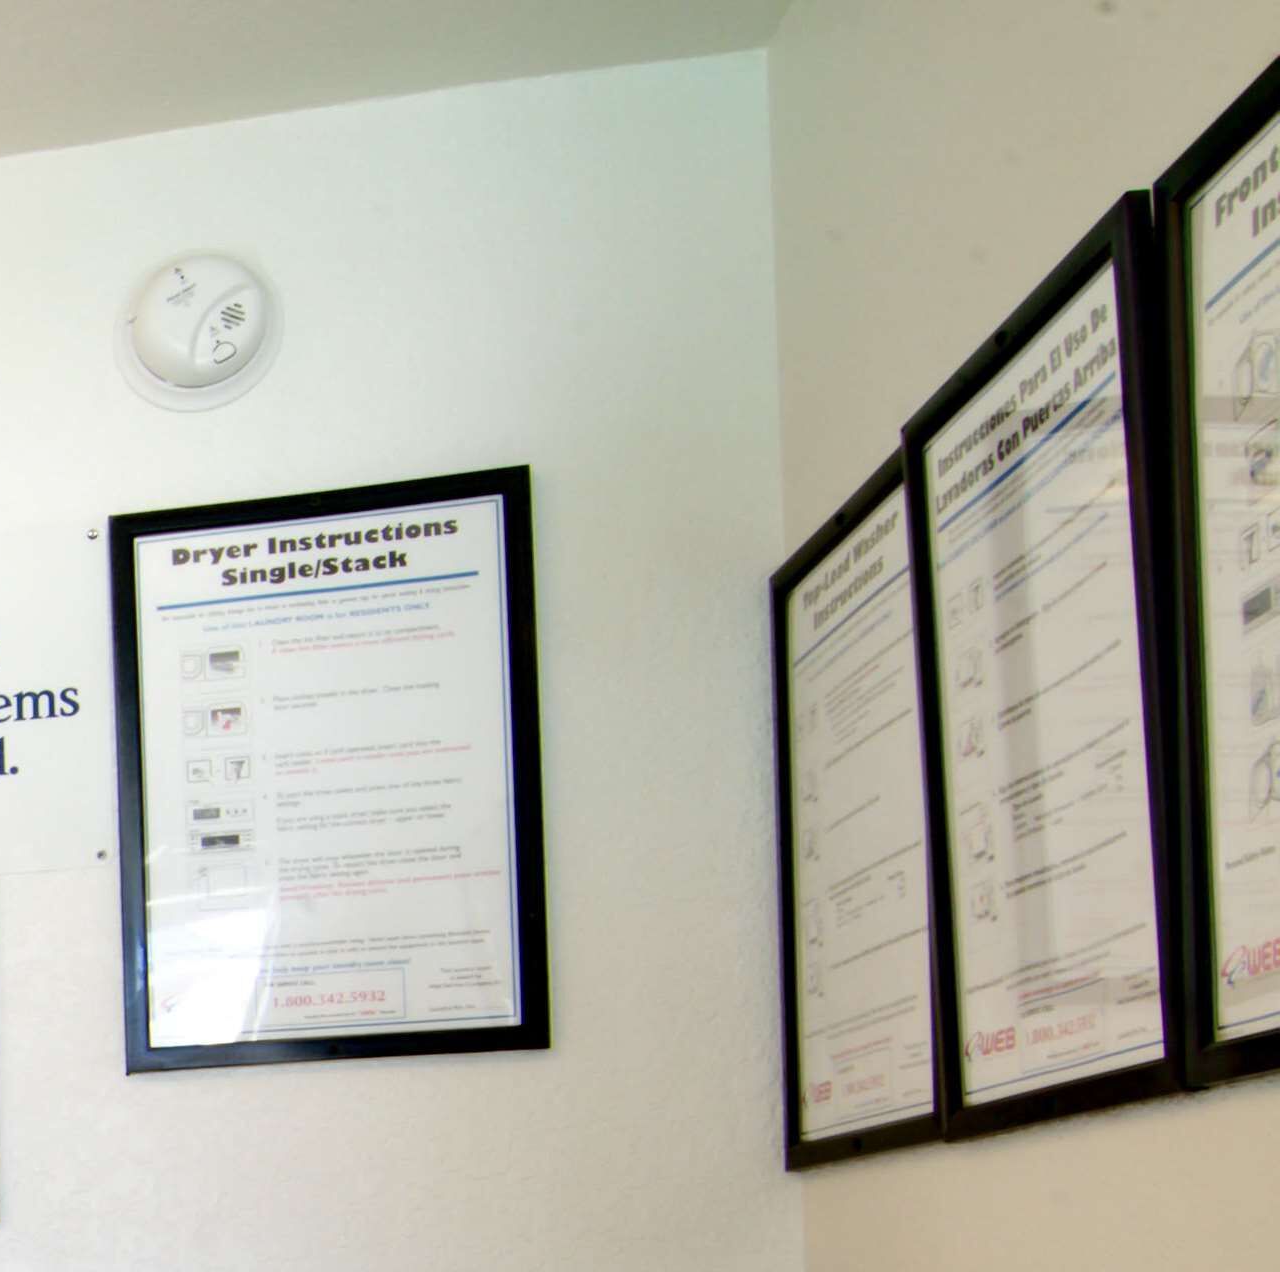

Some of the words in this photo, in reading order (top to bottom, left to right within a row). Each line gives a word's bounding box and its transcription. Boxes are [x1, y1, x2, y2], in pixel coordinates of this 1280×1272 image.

[1252, 191, 1280, 238] In
[1073, 336, 1116, 392] Arriba
[938, 395, 1017, 478] Instrucciones
[1019, 364, 1048, 404] Para
[1049, 345, 1062, 374] El
[1091, 303, 1108, 334] De
[172, 540, 258, 567] Dryer
[267, 517, 459, 555] Instructions
[221, 549, 408, 587] Single/Stack
